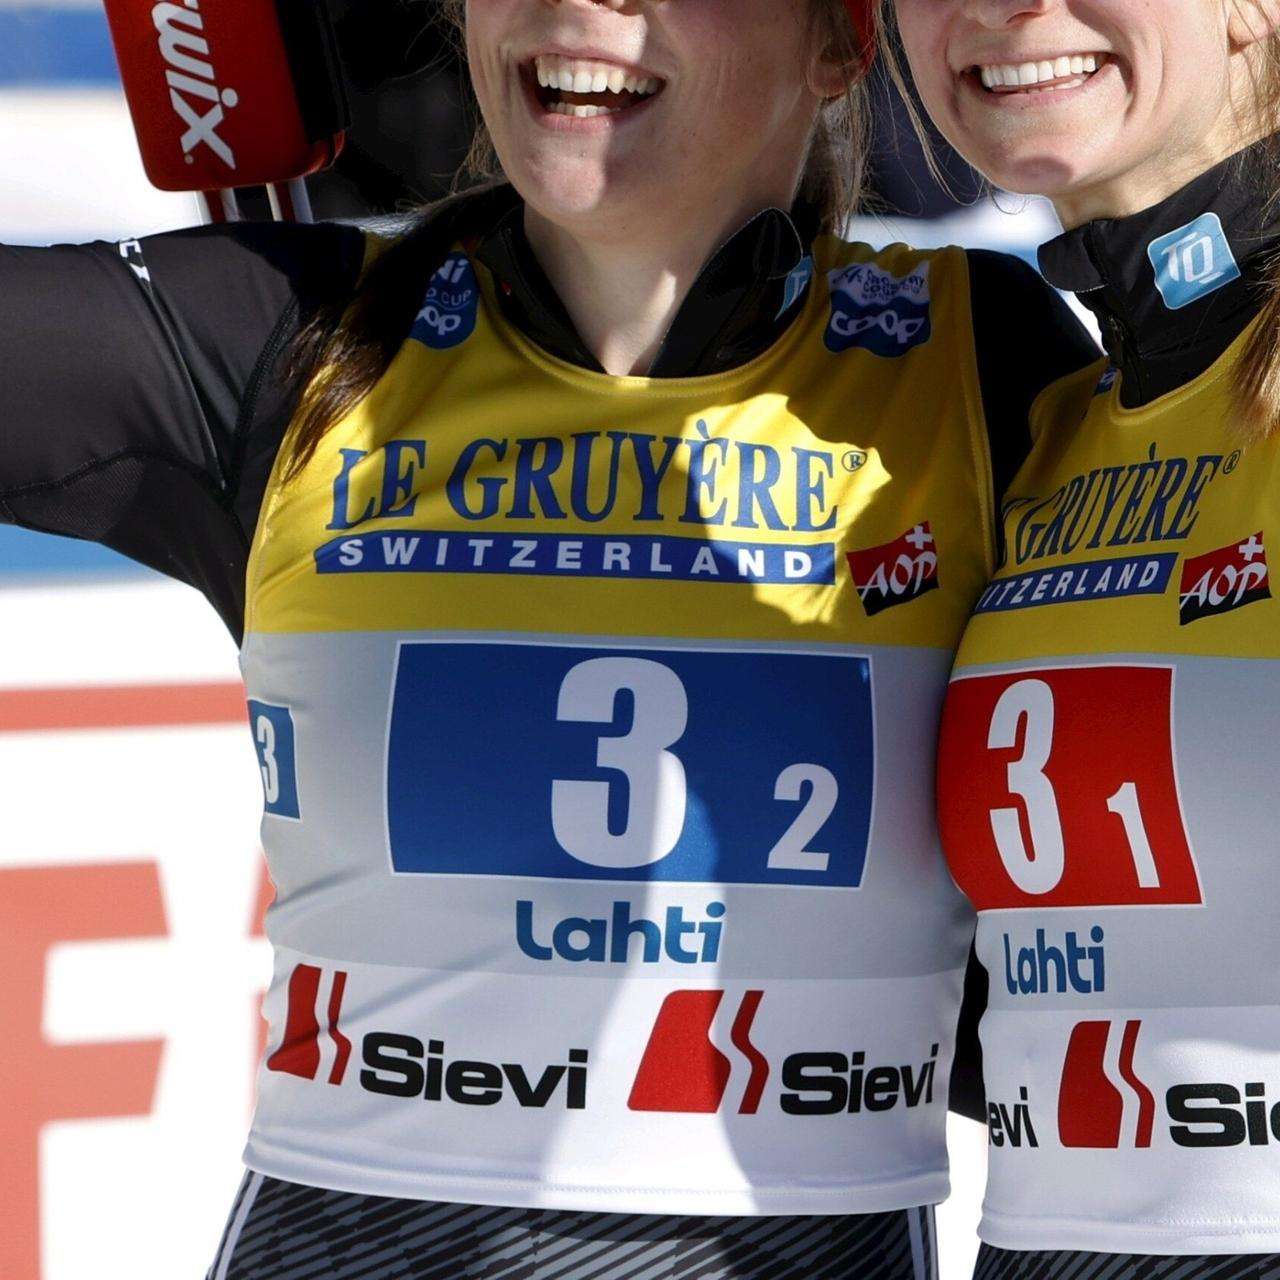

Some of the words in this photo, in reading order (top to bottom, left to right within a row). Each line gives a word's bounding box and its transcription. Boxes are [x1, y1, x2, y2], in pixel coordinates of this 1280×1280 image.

[326, 438, 425, 531] LE
[338, 536, 812, 579] SWITZERLAND
[855, 546, 939, 600] AOP
[981, 560, 1160, 608] ITZERLAND
[1179, 561, 1268, 610] AOP
[255, 713, 281, 805] 3
[550, 655, 689, 870] 3
[766, 762, 840, 872] 2
[986, 678, 1065, 896] 3
[1106, 781, 1161, 889] 1
[359, 1031, 589, 1110] Sievi
[780, 1043, 940, 1117] Sievi
[987, 1085, 1039, 1148] evi
